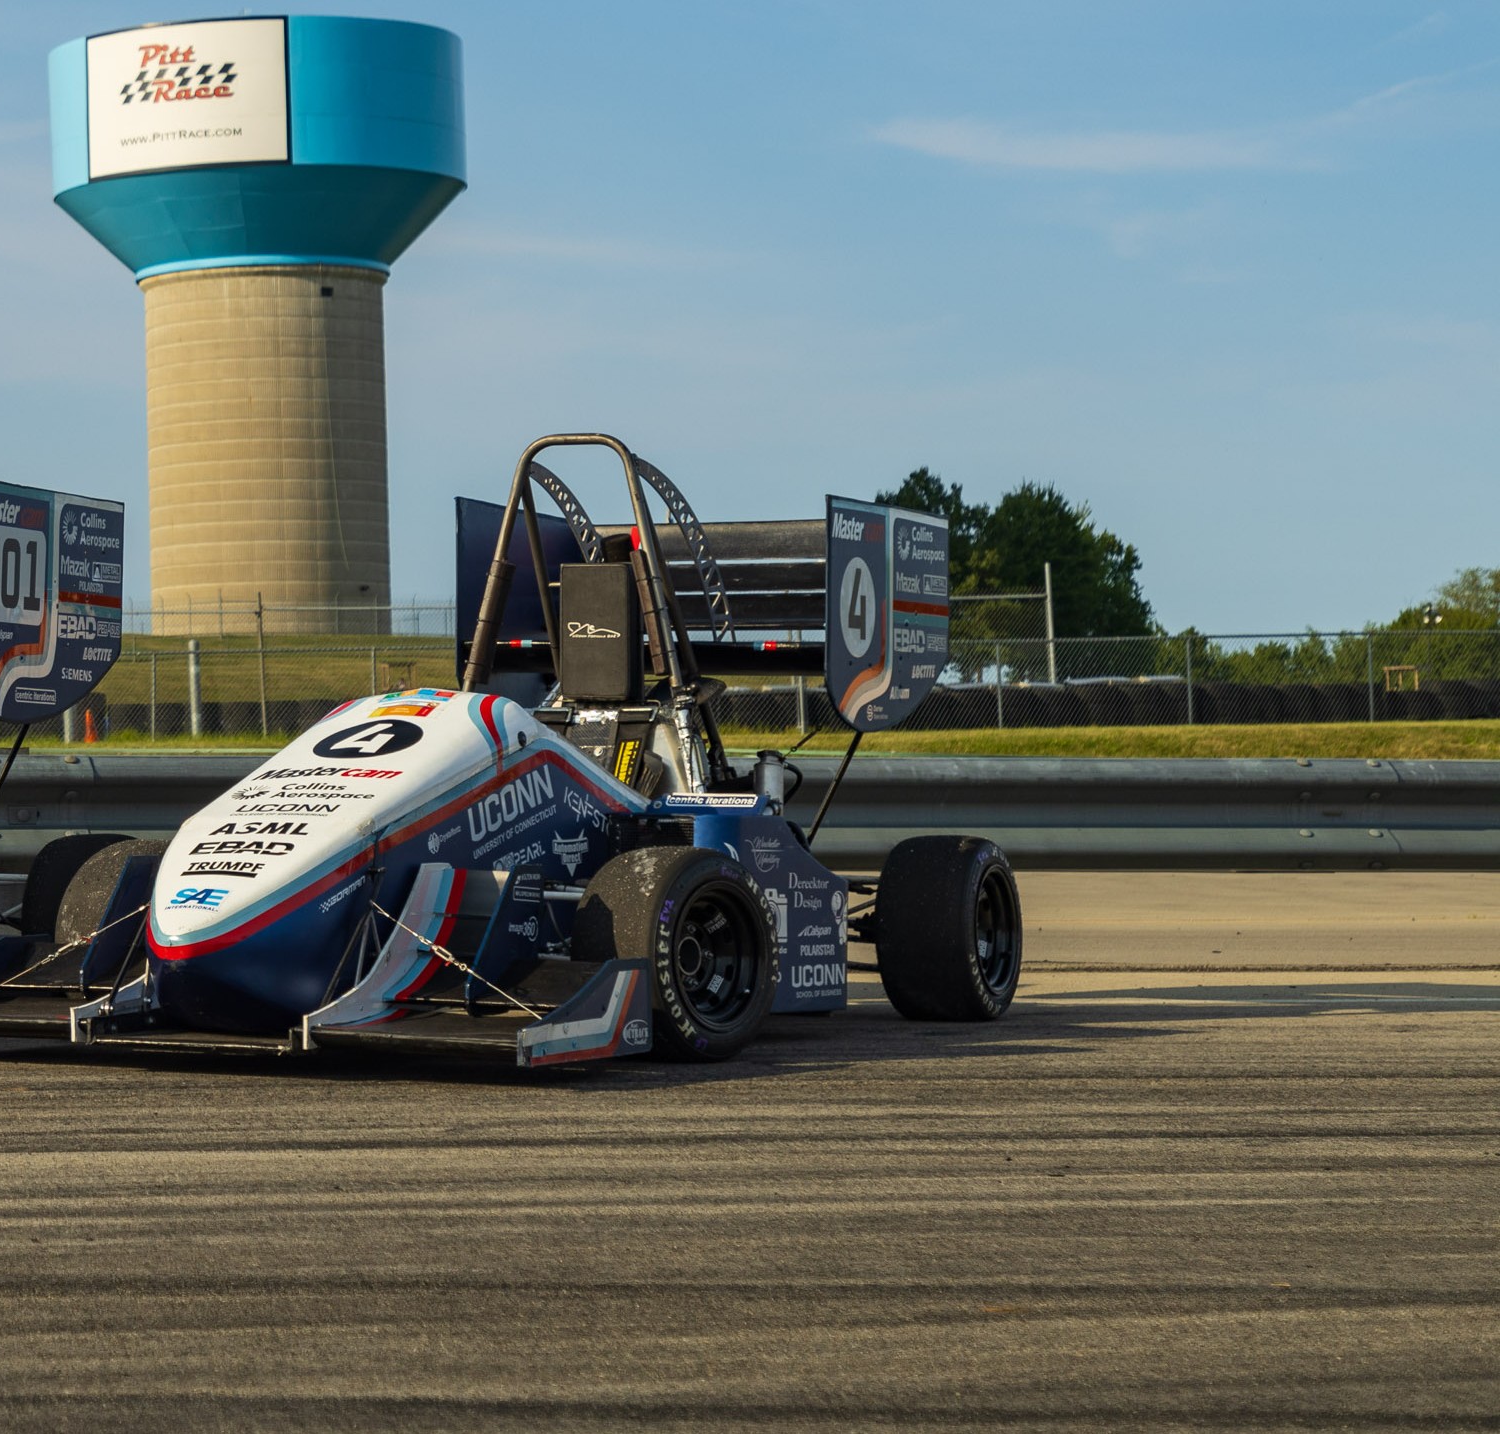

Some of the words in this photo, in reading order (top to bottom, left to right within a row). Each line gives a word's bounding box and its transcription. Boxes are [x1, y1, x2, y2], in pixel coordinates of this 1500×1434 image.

[137, 44, 196, 69] Pitt
[153, 79, 235, 104] Race
[80, 512, 107, 530] Collins
[80, 531, 120, 551] Aerospace
[911, 525, 934, 543] Collins
[911, 544, 946, 565] Aerospace
[60, 555, 91, 578] Mazak
[895, 571, 921, 595] Mazak
[848, 567, 867, 641] 4
[57, 614, 97, 640] EBAD
[893, 627, 926, 654] EBAD
[82, 647, 113, 662] LOCTITE
[61, 667, 93, 683] SIEMENS
[911, 664, 936, 680] LOCTITE
[329, 723, 396, 753] 4
[252, 766, 404, 781] Mastercam
[270, 791, 375, 800] Aerospace
[281, 783, 347, 791] Collins
[235, 804, 341, 813] UCONN
[467, 764, 555, 842] UCONN
[668, 795, 703, 805] centric
[705, 796, 755, 806] iterations
[208, 822, 309, 836] ASML
[473, 832, 505, 860] UNIVERSITY
[505, 827, 514, 840] OF
[514, 804, 557, 835] CONNECTICUT
[188, 841, 295, 856] EBAD
[553, 842, 589, 853] Automation
[187, 861, 266, 872] TRUMPF
[562, 853, 582, 863] Direct
[329, 875, 366, 905] GORMAN
[788, 872, 829, 890] Derecktor
[169, 888, 230, 906] SAE
[794, 891, 822, 911] Design
[806, 925, 832, 938] Calspan
[800, 943, 836, 957] POLARSTAR
[656, 924, 697, 1038] Hoosier
[791, 963, 846, 988] UCONN
[796, 990, 814, 999] SCHOOL
[814, 989, 821, 998] OF
